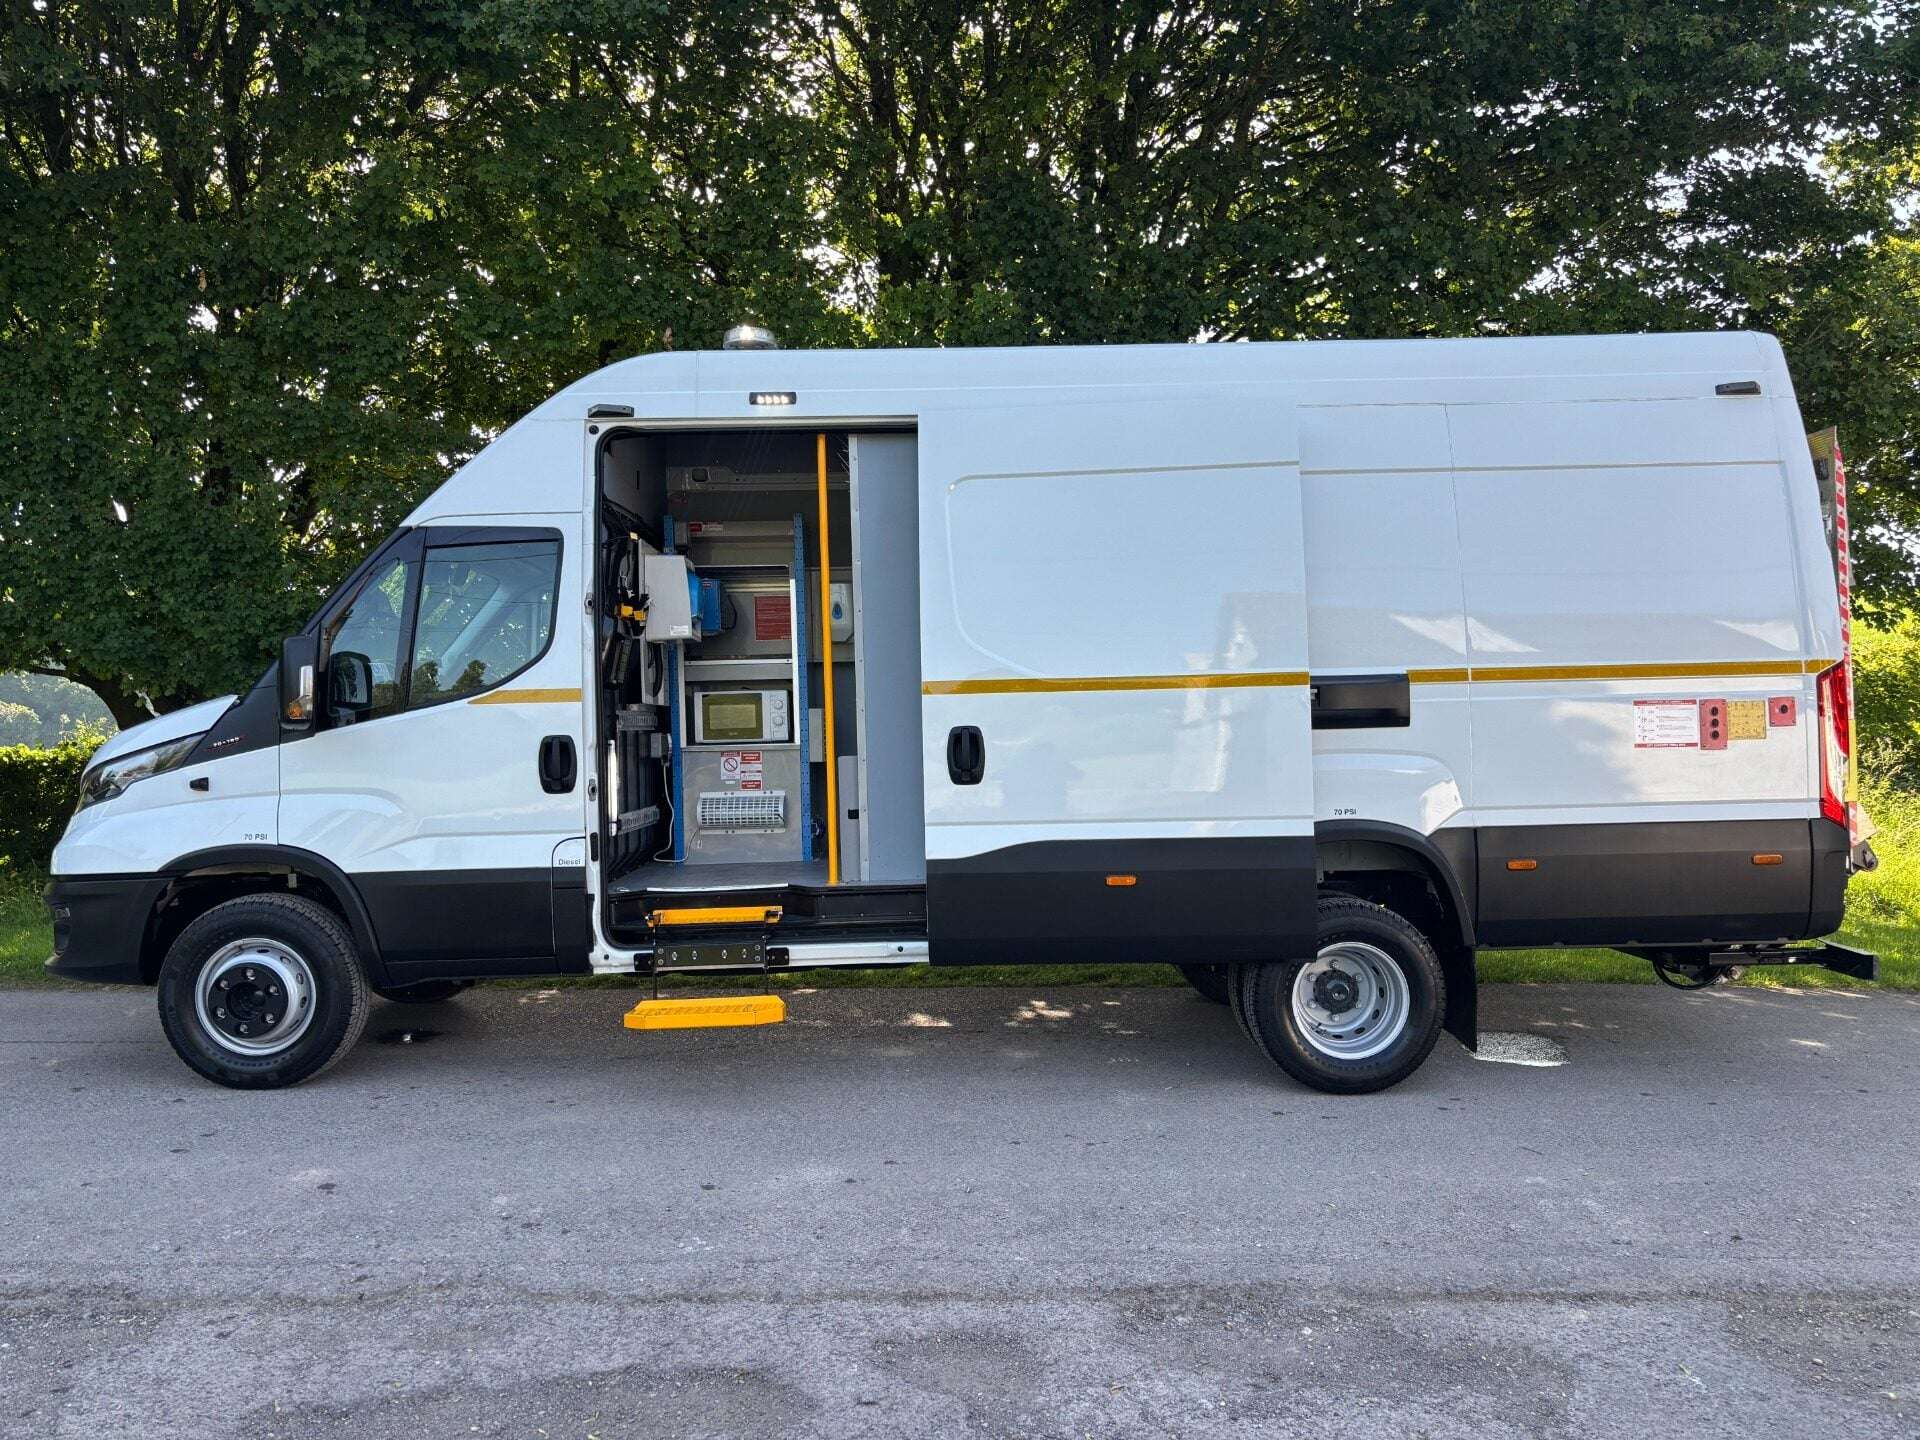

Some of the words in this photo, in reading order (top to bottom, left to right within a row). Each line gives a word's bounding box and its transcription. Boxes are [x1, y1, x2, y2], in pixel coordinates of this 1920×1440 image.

[1333, 808, 1343, 816] 70
[1344, 808, 1357, 816] PSI
[244, 833, 253, 841] 70
[255, 833, 268, 841] PSI
[558, 858, 581, 866] Diesel
